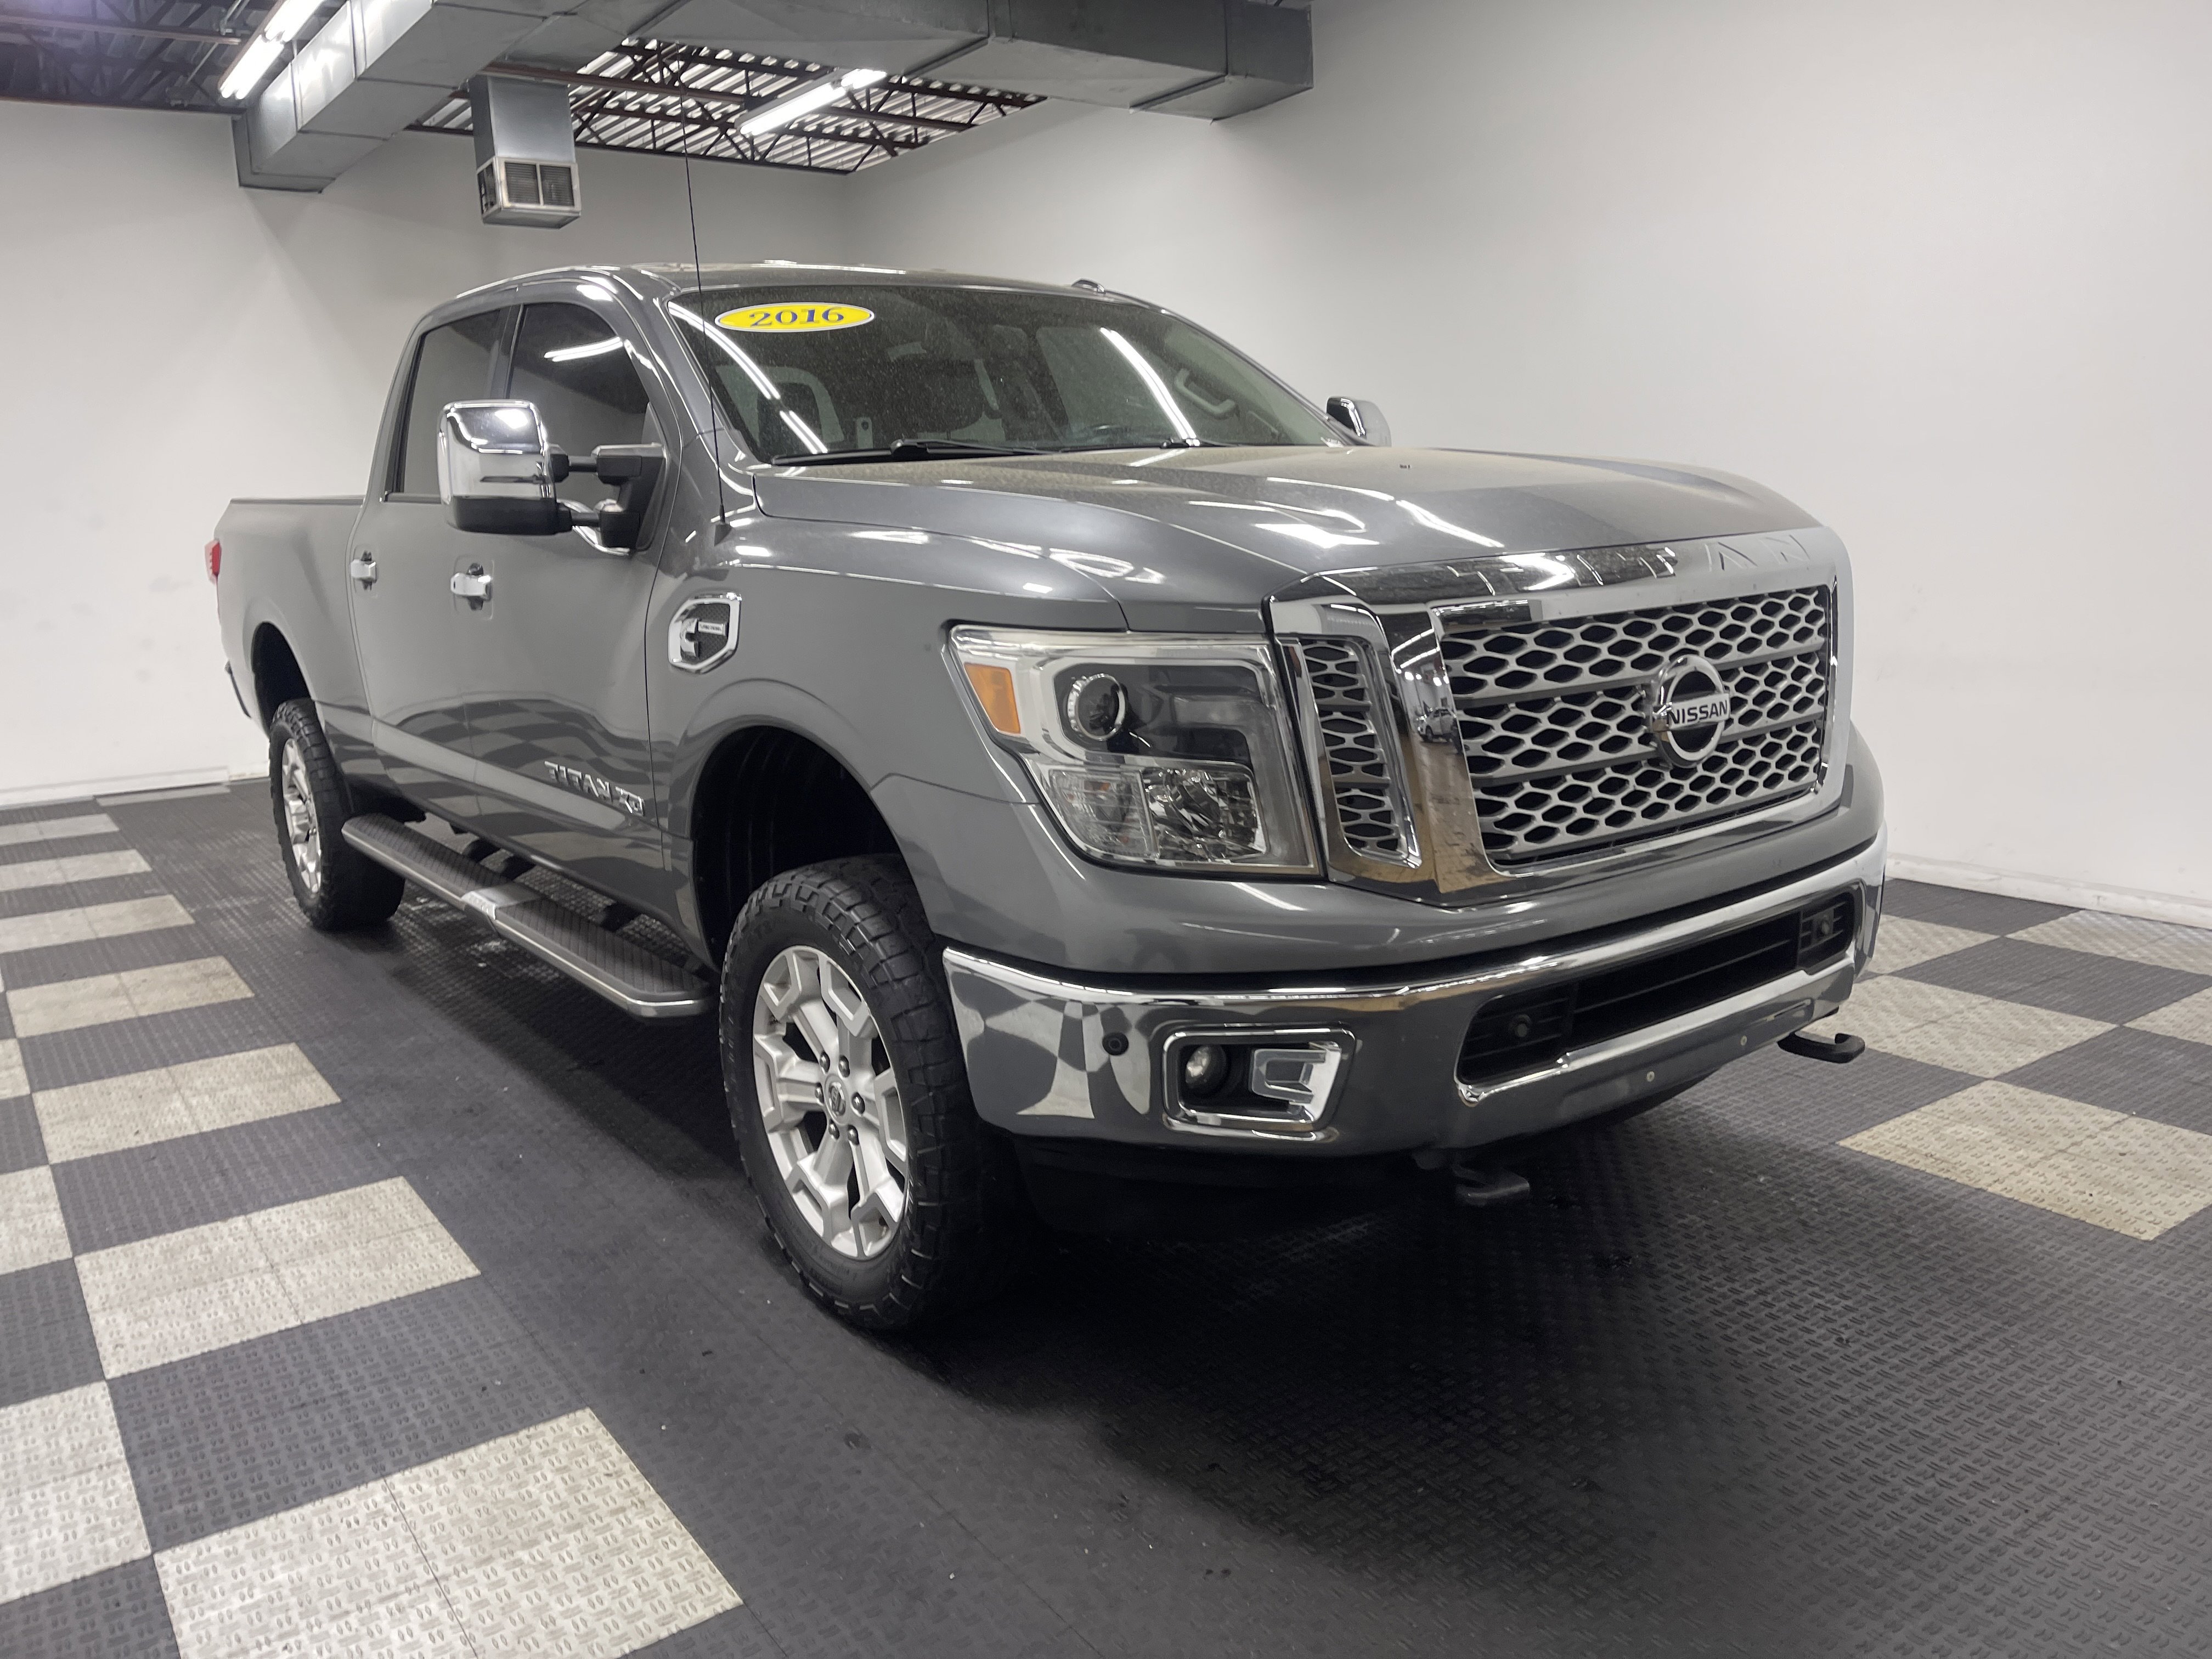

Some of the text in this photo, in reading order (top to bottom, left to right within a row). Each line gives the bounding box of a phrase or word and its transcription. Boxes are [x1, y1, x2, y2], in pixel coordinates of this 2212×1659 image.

[749, 307, 844, 326] 2016
[1667, 699, 1728, 724] NISSAN
[544, 760, 613, 803] TITAN
